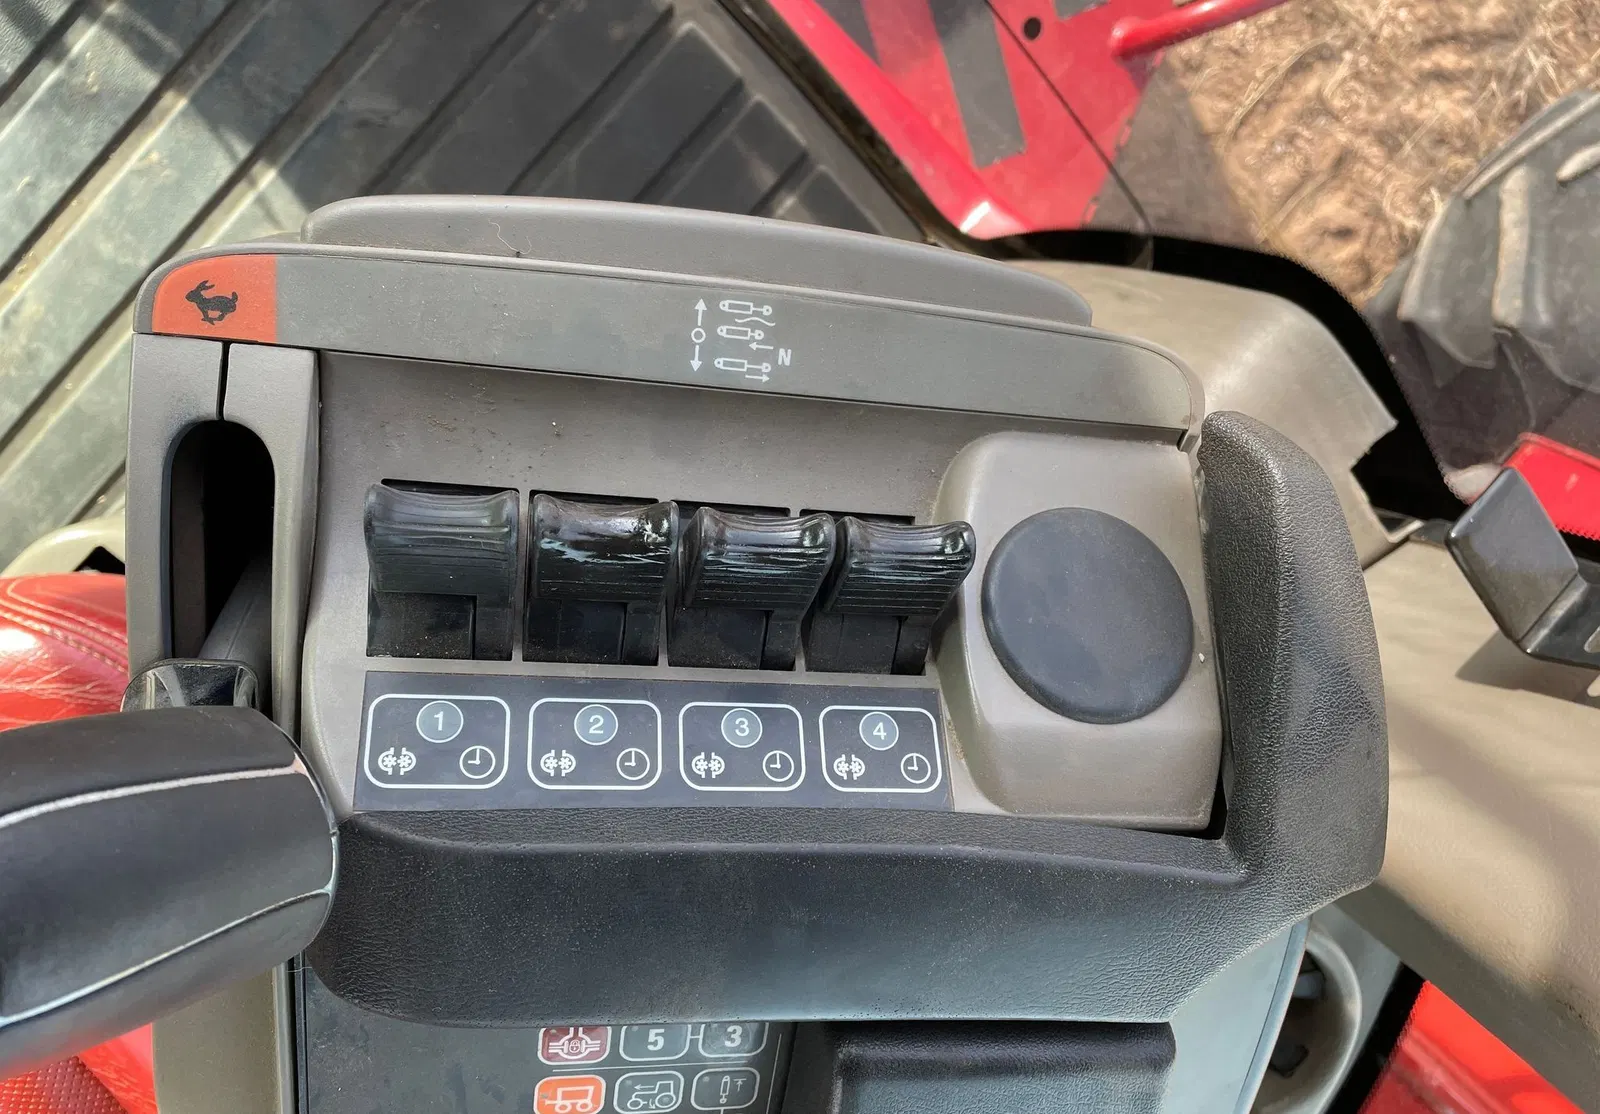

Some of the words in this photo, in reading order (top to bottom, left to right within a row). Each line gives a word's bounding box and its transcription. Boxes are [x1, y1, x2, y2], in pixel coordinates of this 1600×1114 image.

[777, 348, 792, 366] N
[433, 711, 446, 731] 1
[588, 715, 604, 734] 2
[734, 717, 750, 737] 3
[872, 720, 887, 740] 4
[646, 1028, 665, 1051] 5
[724, 1024, 743, 1047] 3
